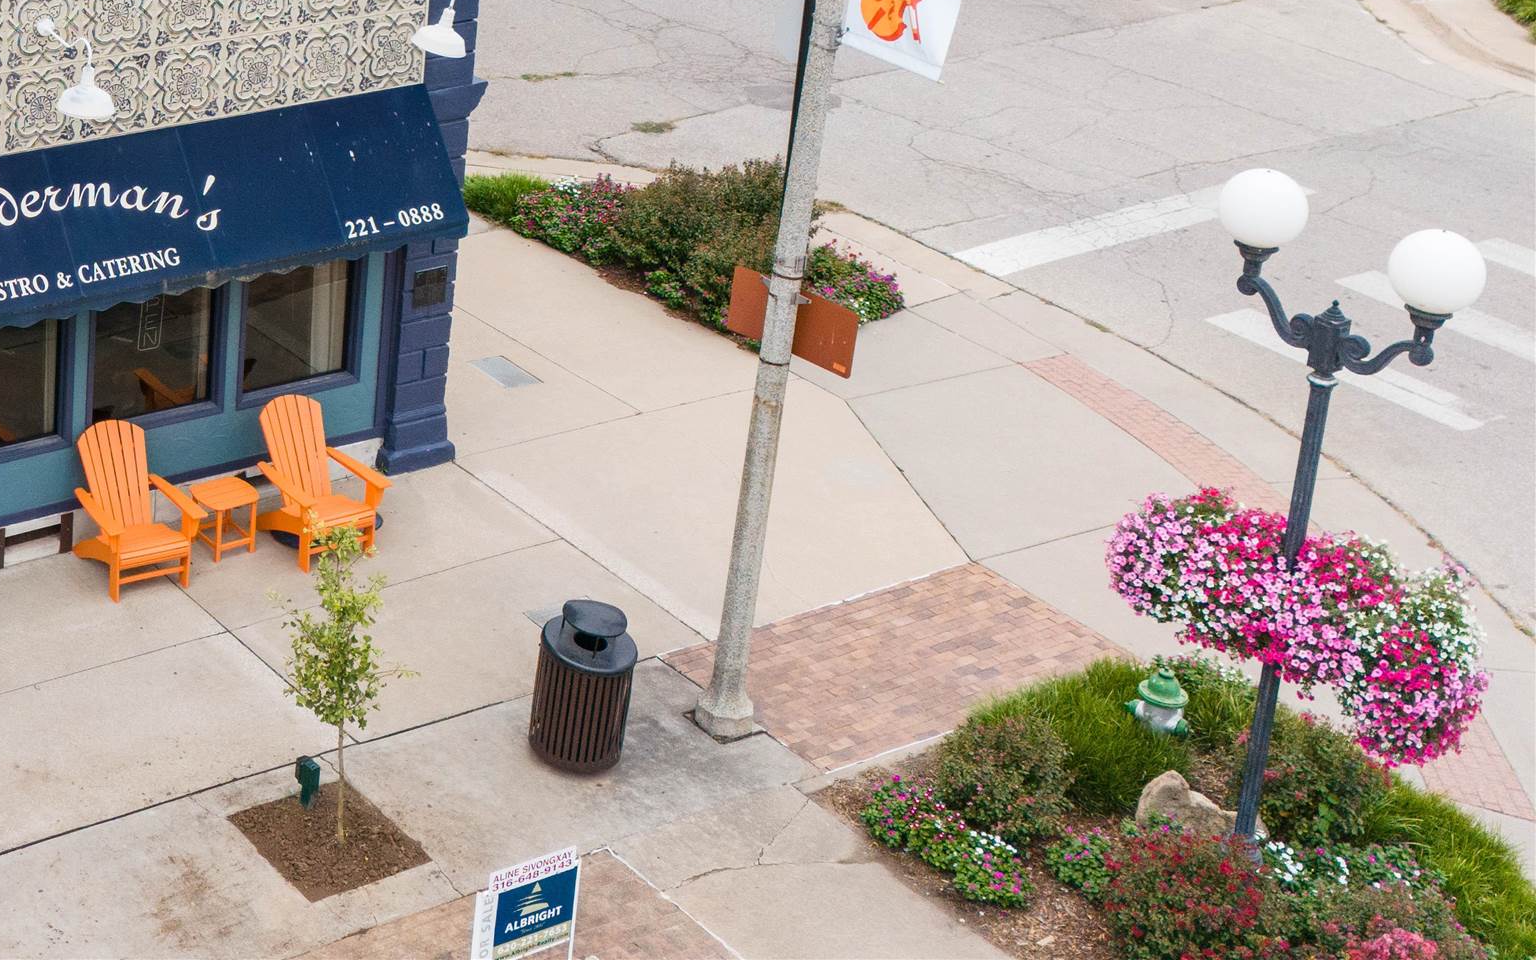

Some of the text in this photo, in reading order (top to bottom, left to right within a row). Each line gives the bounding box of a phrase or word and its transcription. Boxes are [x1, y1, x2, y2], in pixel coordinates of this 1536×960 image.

[345, 216, 380, 239] 221
[398, 203, 444, 227] 0888
[56, 271, 74, 289] &
[77, 247, 181, 284] CATERING
[492, 859, 572, 892] 316-648-9143
[493, 850, 573, 883] ALINE SIVONGXAY
[504, 905, 563, 933] ALBRIGHT
